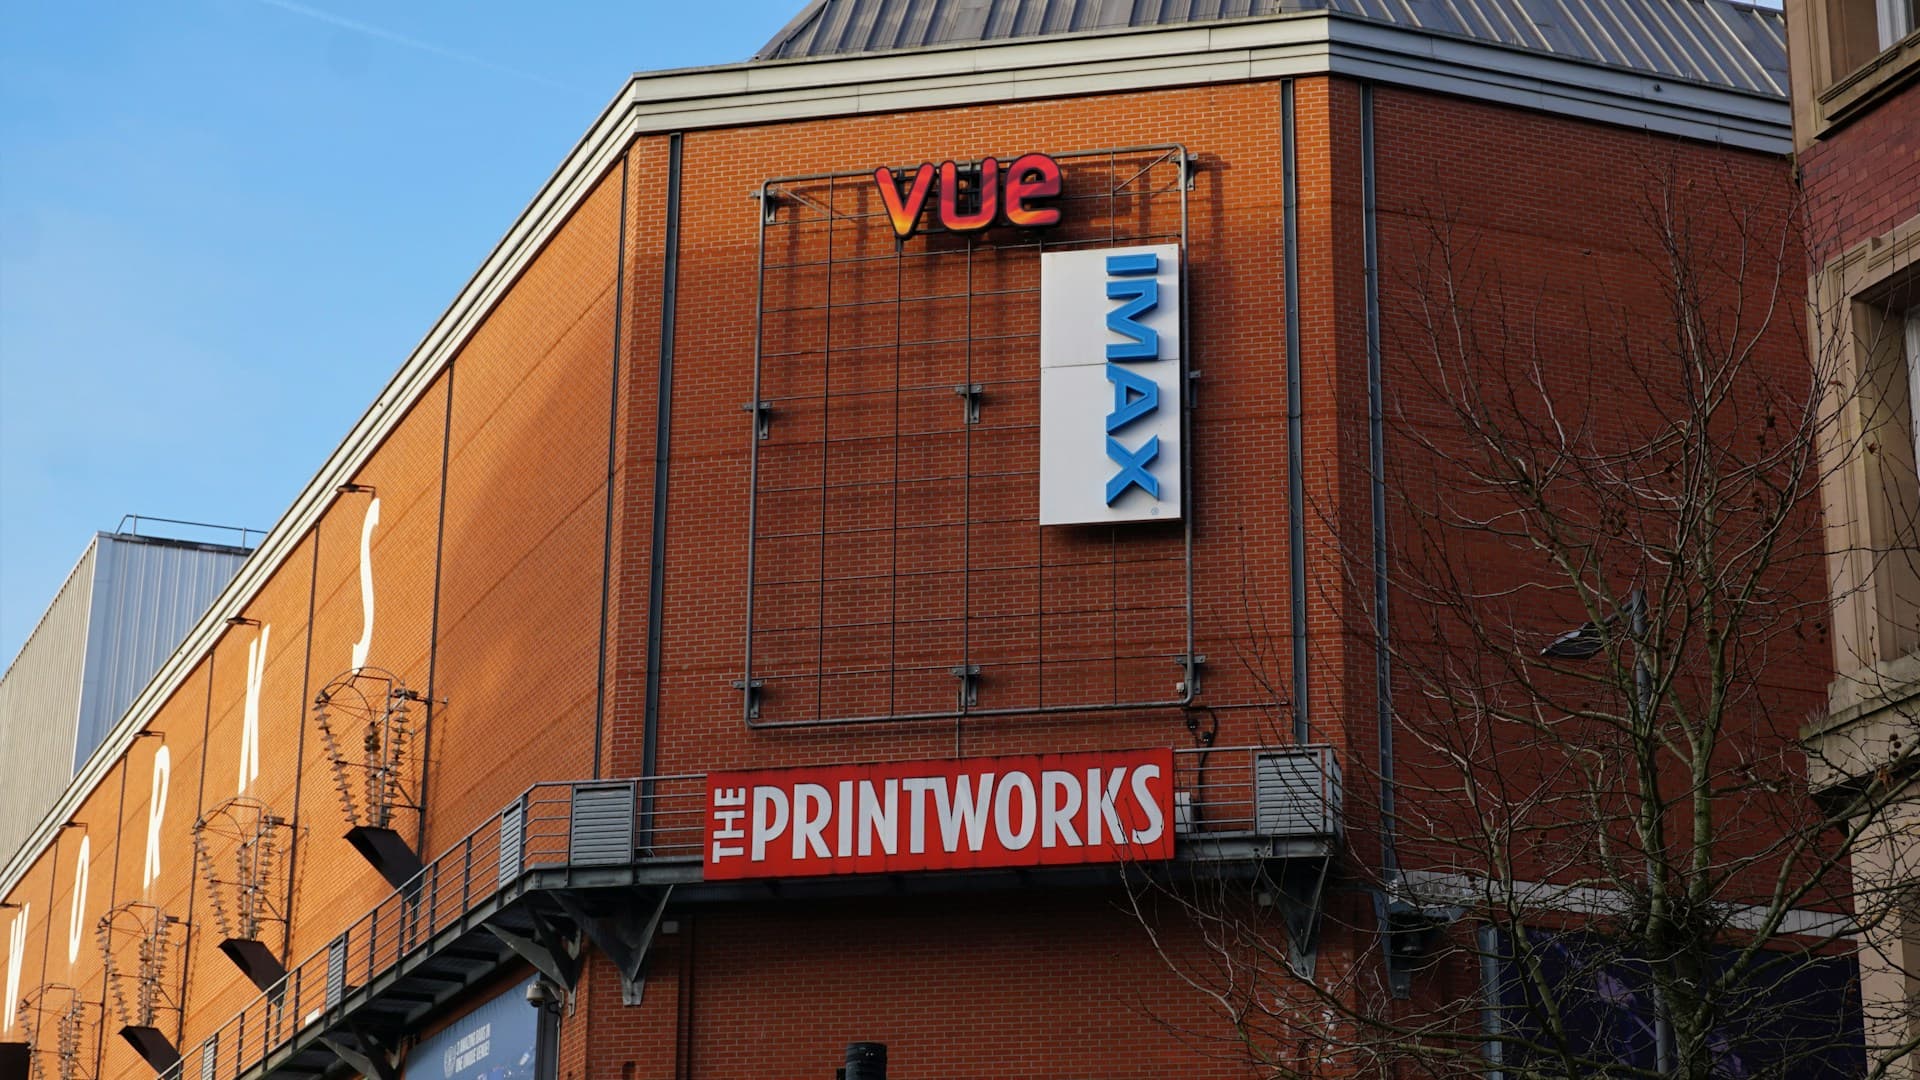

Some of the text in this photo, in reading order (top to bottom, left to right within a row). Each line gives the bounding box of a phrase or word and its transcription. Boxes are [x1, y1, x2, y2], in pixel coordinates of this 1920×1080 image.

[1106, 253, 1159, 507] IMAX
[712, 764, 1164, 863] THE PRINTWORKS
